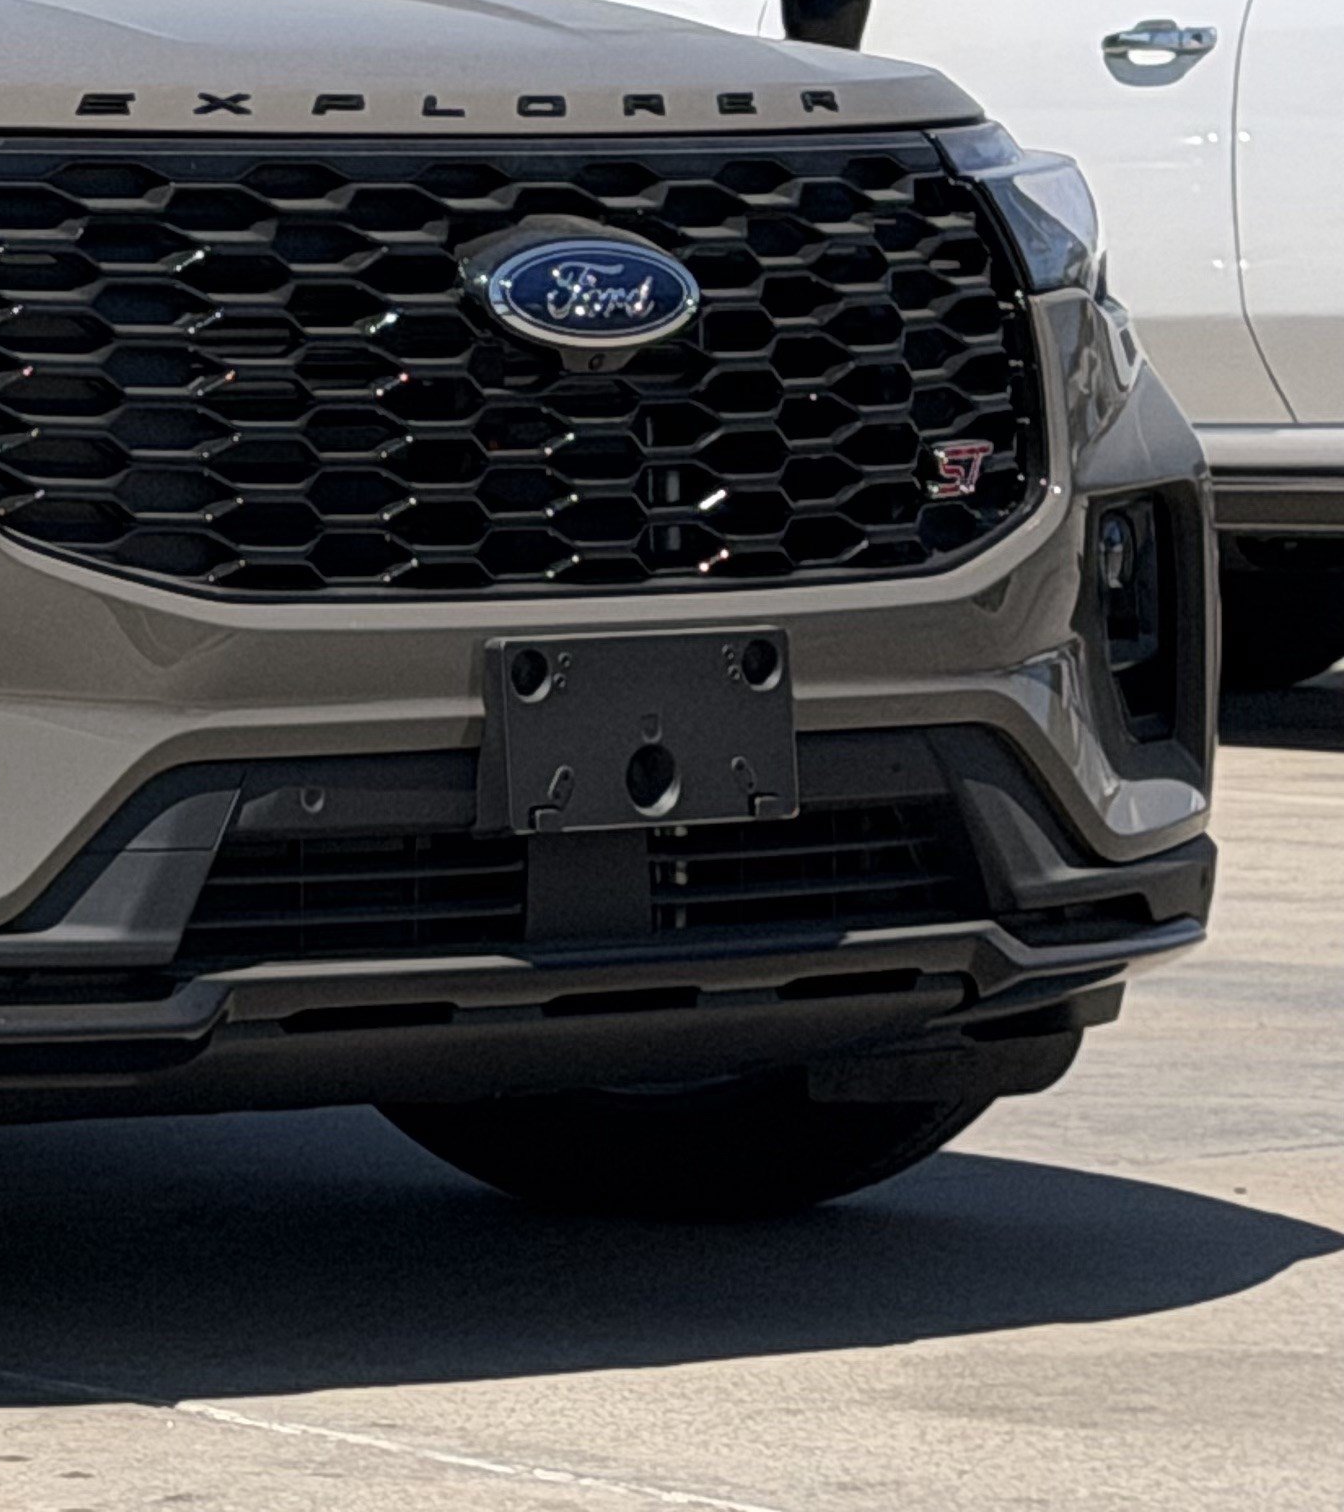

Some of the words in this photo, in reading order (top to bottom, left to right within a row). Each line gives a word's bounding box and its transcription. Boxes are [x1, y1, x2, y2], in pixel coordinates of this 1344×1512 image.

[75, 91, 844, 119] EXPLORER
[547, 261, 656, 320] Ford
[926, 439, 995, 500] ST
